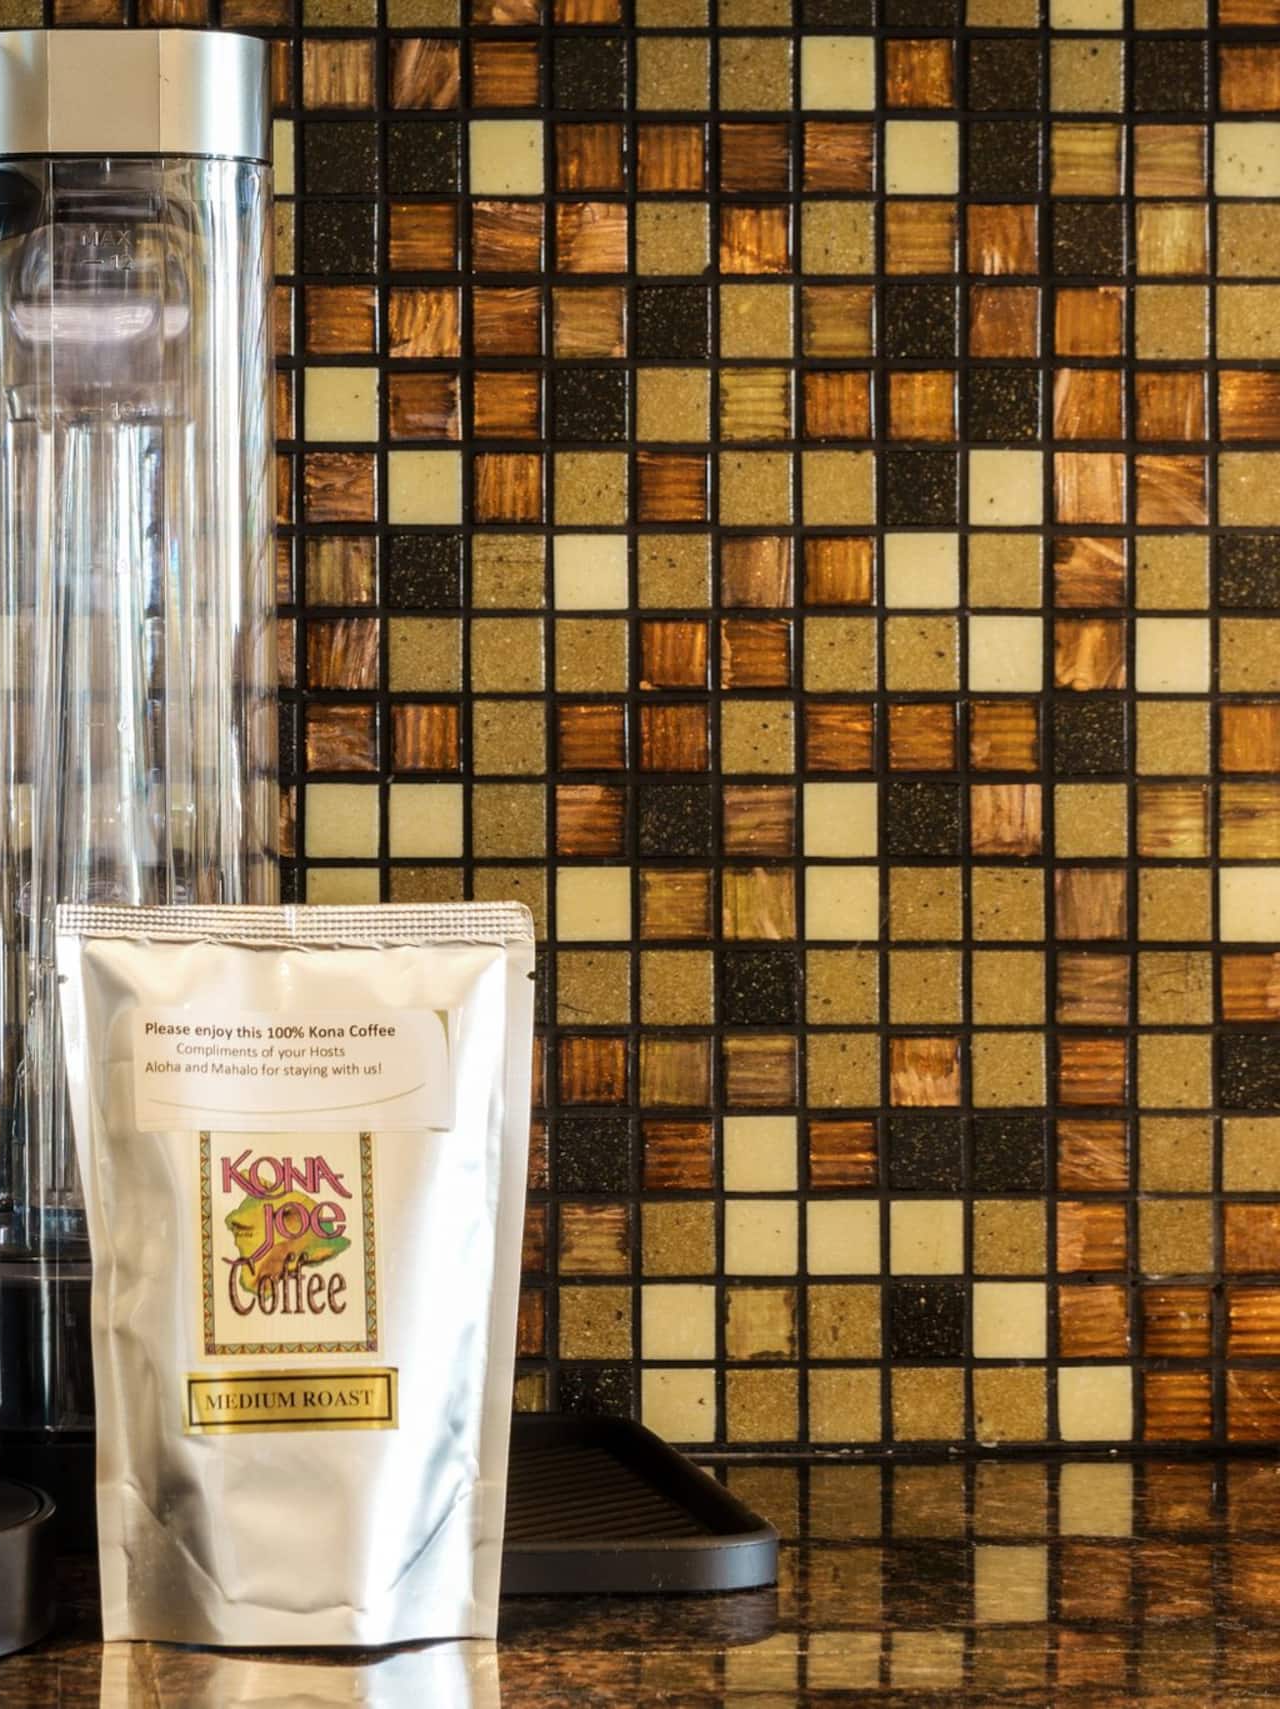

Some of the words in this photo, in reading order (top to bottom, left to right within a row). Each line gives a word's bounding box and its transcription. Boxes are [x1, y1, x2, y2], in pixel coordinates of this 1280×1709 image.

[81, 229, 132, 248] MAX
[145, 1022, 191, 1036] Please
[195, 1024, 233, 1040] enjoy
[237, 1026, 262, 1039] this
[267, 1026, 305, 1039] 100%
[309, 1026, 345, 1038] Kona
[349, 1024, 396, 1037] Coffee
[176, 1042, 258, 1058] Compliments
[261, 1045, 275, 1057] of
[278, 1047, 307, 1060] your
[310, 1046, 345, 1058] Hosts
[145, 1060, 181, 1073] Aloha
[185, 1062, 209, 1074] and
[211, 1062, 258, 1076] Mahalo
[261, 1064, 280, 1076] for
[283, 1064, 328, 1078] staying
[332, 1063, 359, 1075] with
[363, 1061, 382, 1075] us!
[220, 1149, 352, 1199] KONA
[228, 1251, 347, 1316] Coffee
[205, 1390, 296, 1411] MEDIUM
[302, 1388, 374, 1408] ROAST
